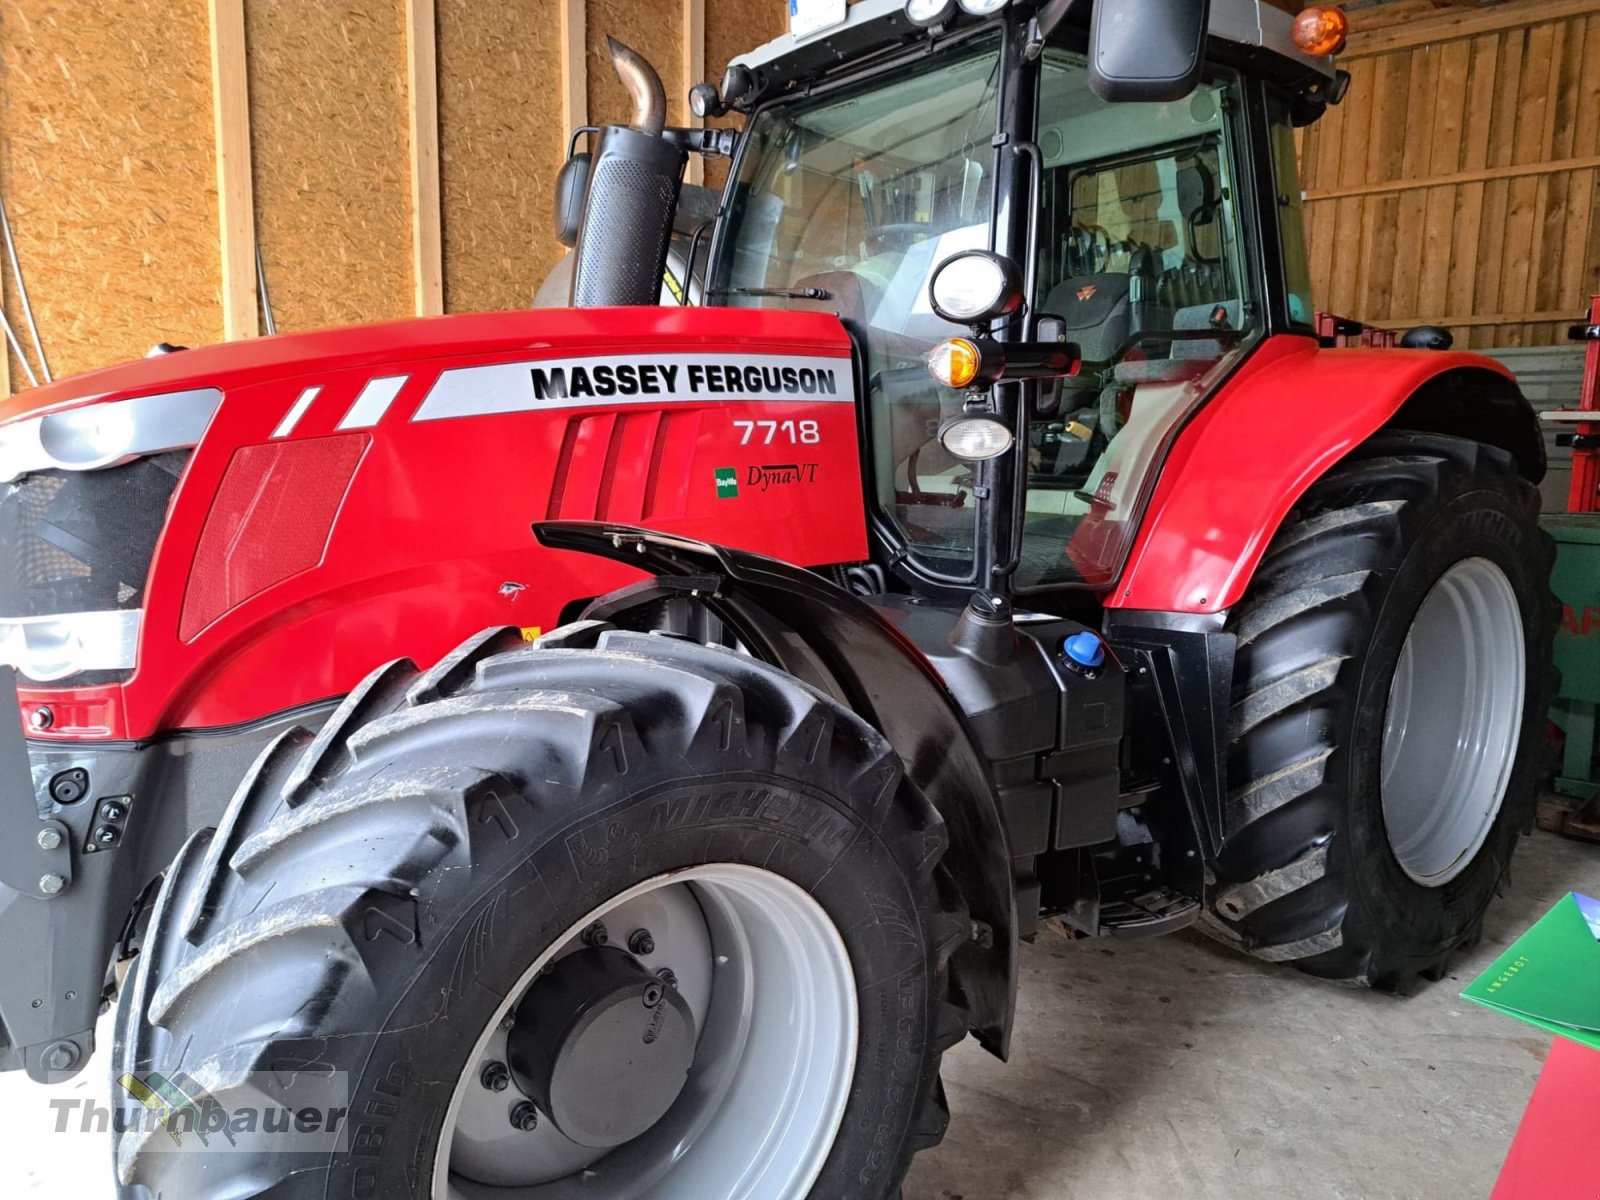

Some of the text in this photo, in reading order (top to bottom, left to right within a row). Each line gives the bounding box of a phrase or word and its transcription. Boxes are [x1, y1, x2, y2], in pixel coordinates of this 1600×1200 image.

[530, 364, 837, 400] MASSEY FERGUSON
[733, 420, 820, 445] 7718
[651, 789, 854, 848] MICHELIN
